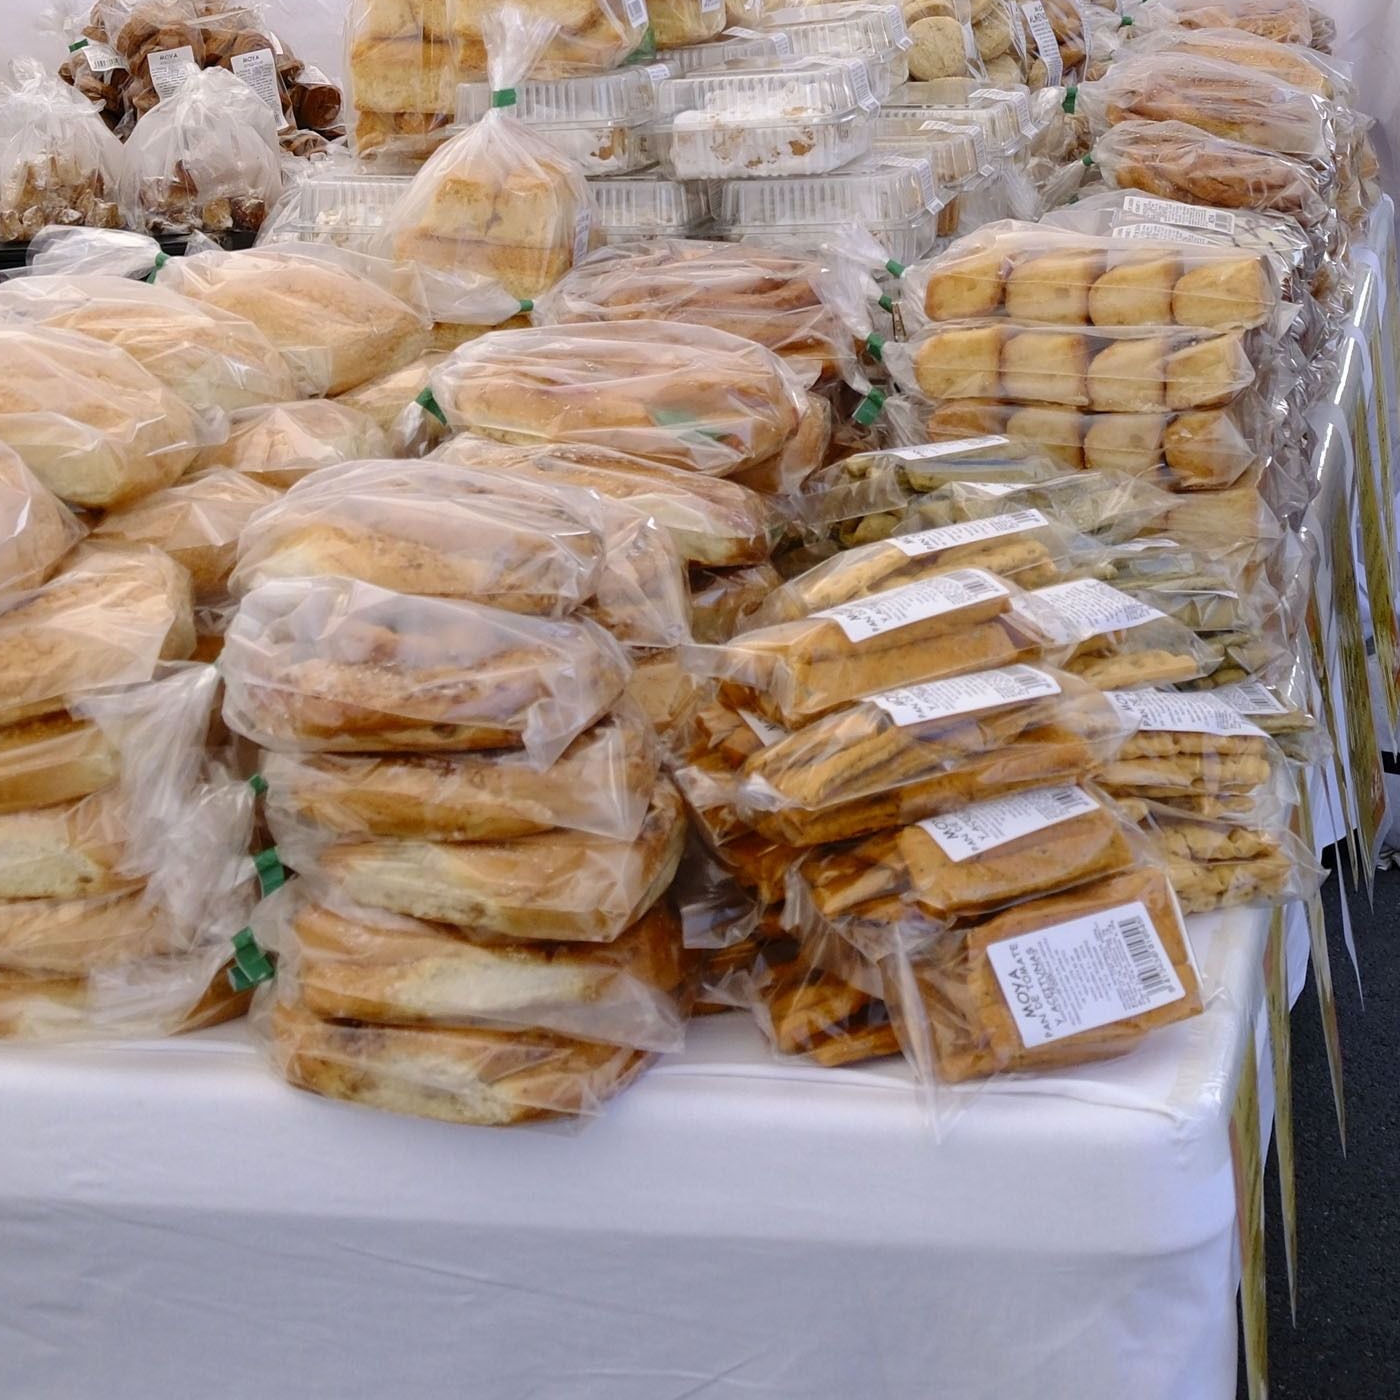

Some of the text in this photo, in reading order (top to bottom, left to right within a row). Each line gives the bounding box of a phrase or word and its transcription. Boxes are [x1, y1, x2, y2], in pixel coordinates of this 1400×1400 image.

[961, 833, 980, 851] PAN
[1008, 969, 1036, 1018] MOYA
[1009, 943, 1053, 1038] PAN DE TOMATE
[1055, 1016, 1067, 1027] Y
